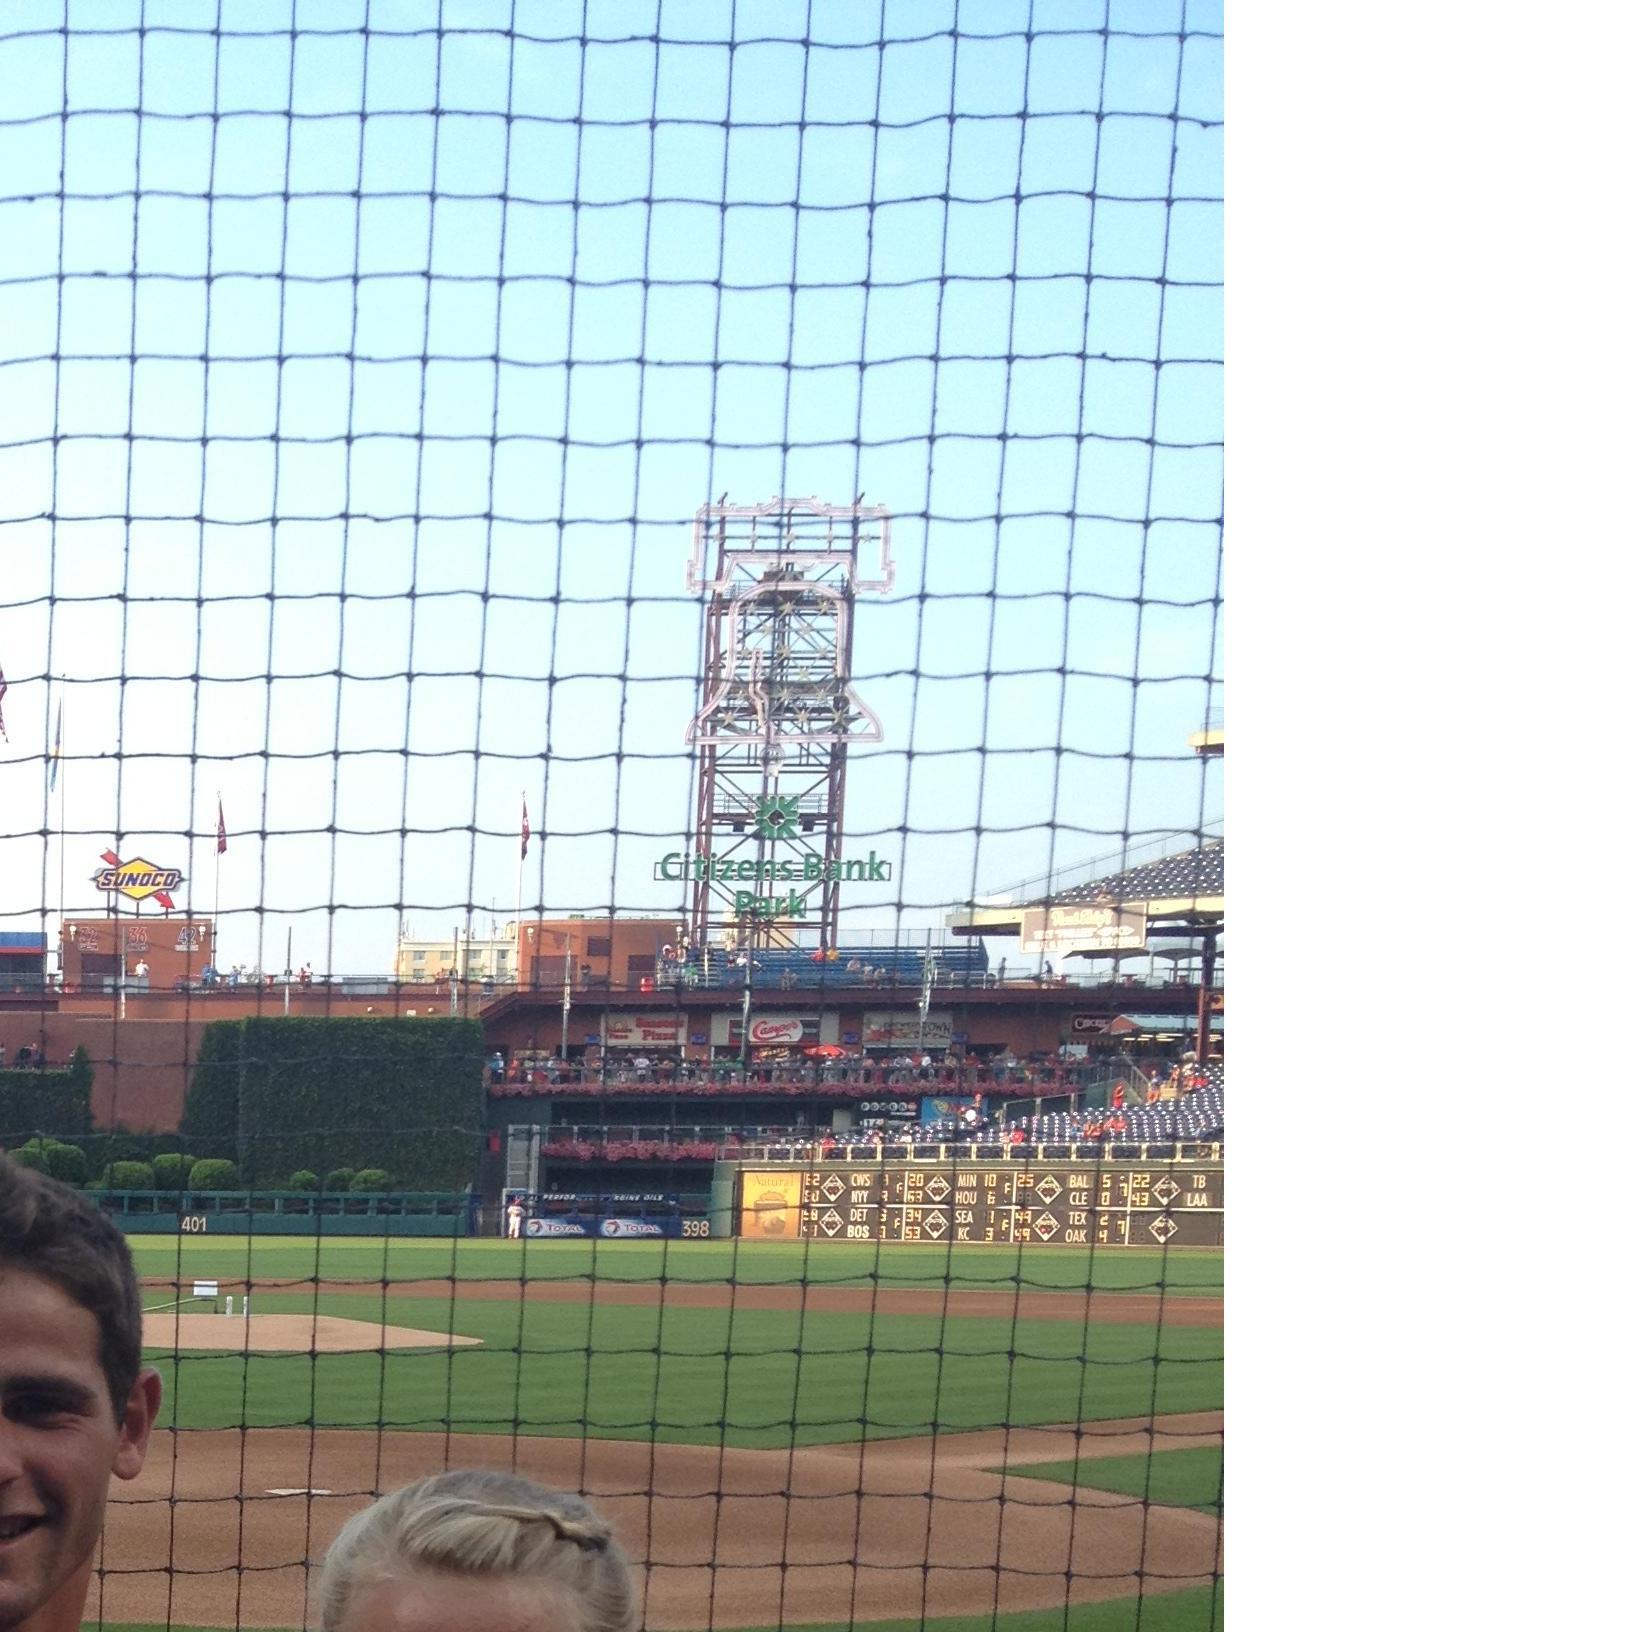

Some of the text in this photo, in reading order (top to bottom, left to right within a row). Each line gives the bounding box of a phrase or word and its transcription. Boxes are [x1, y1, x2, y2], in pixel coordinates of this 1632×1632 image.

[660, 851, 887, 881] Citizens Bank
[101, 872, 177, 887] SUNOCO
[734, 888, 806, 918] Park
[851, 1173, 871, 1187] CWS
[958, 1174, 977, 1187] MIN
[984, 1174, 997, 1187] 10
[1017, 1174, 1111, 1188] 25 BAL 5
[1132, 1174, 1206, 1188] 22 TB
[1004, 1182, 1012, 1194] F
[851, 1190, 869, 1203] NYY
[955, 1191, 977, 1204] HOU
[1069, 1191, 1088, 1205] CLE
[1131, 1192, 1208, 1207] 43 LAA
[850, 1208, 869, 1222] DET
[906, 1209, 995, 1224] 34 SEA 1
[1068, 1211, 1087, 1225] TEX
[181, 1216, 206, 1231] 401
[546, 1224, 583, 1233] TOTAL
[624, 1224, 661, 1233] TOTAL
[682, 1221, 709, 1236] 398
[1001, 1219, 1010, 1231] F
[847, 1225, 869, 1239] BOS
[905, 1226, 994, 1241] 53 KC 3
[1065, 1228, 1087, 1242] OAK
[1098, 1229, 1107, 1243] 4
